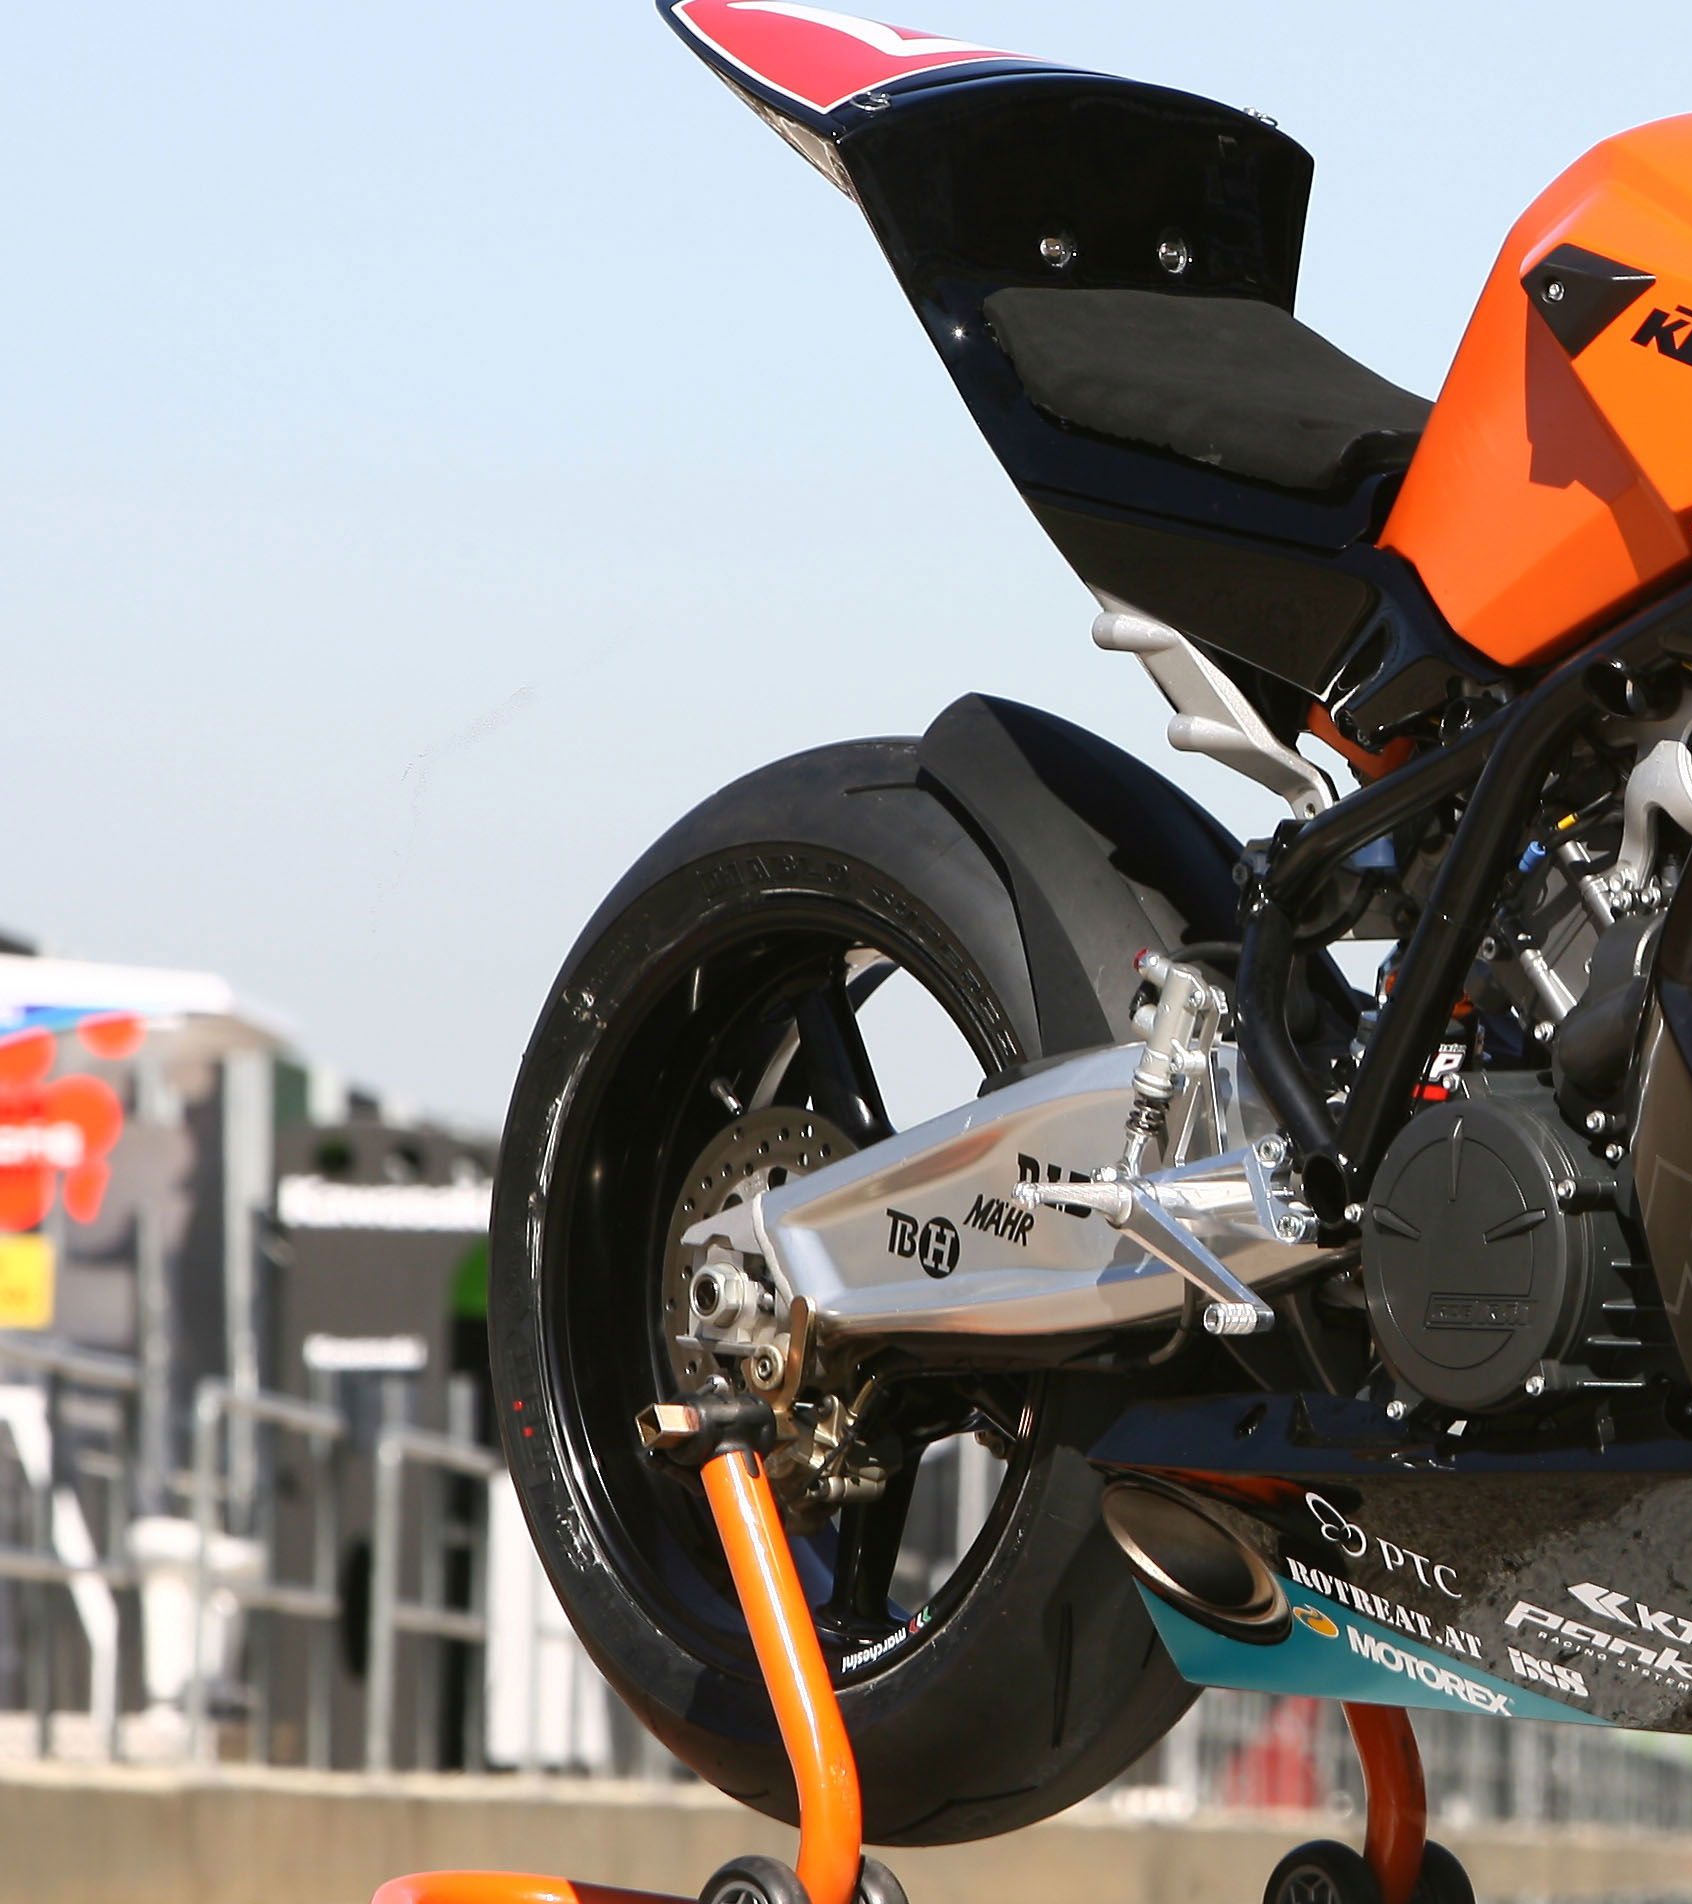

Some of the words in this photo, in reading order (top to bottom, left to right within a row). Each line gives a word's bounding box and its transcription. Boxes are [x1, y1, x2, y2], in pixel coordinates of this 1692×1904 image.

[963, 1193, 1035, 1247] MÄHR
[1376, 1536, 1463, 1598] PTC
[1286, 1556, 1483, 1660] ROTREAT.AT
[842, 1626, 908, 1674] marchesini
[1346, 1625, 1512, 1717] MOTOREX
[1537, 1631, 1608, 1662] RACING
